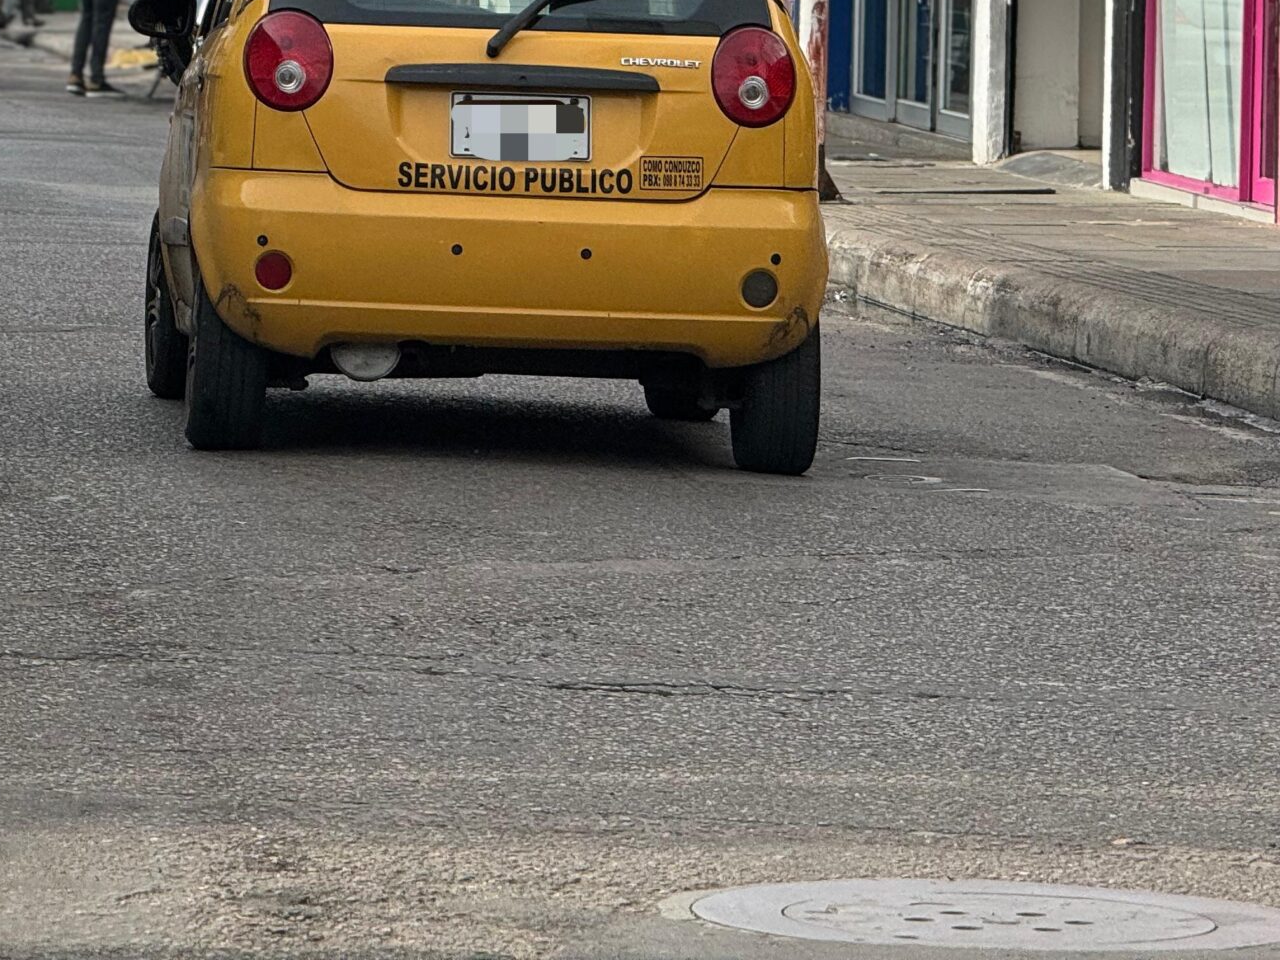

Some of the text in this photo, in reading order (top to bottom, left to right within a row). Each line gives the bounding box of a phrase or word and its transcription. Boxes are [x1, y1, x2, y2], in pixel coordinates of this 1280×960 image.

[621, 57, 702, 69] CHEVROLET
[642, 160, 700, 173] COMO CONDUZCO
[398, 161, 633, 194] SERVICIO PUBLICO
[642, 174, 661, 187] PBX:
